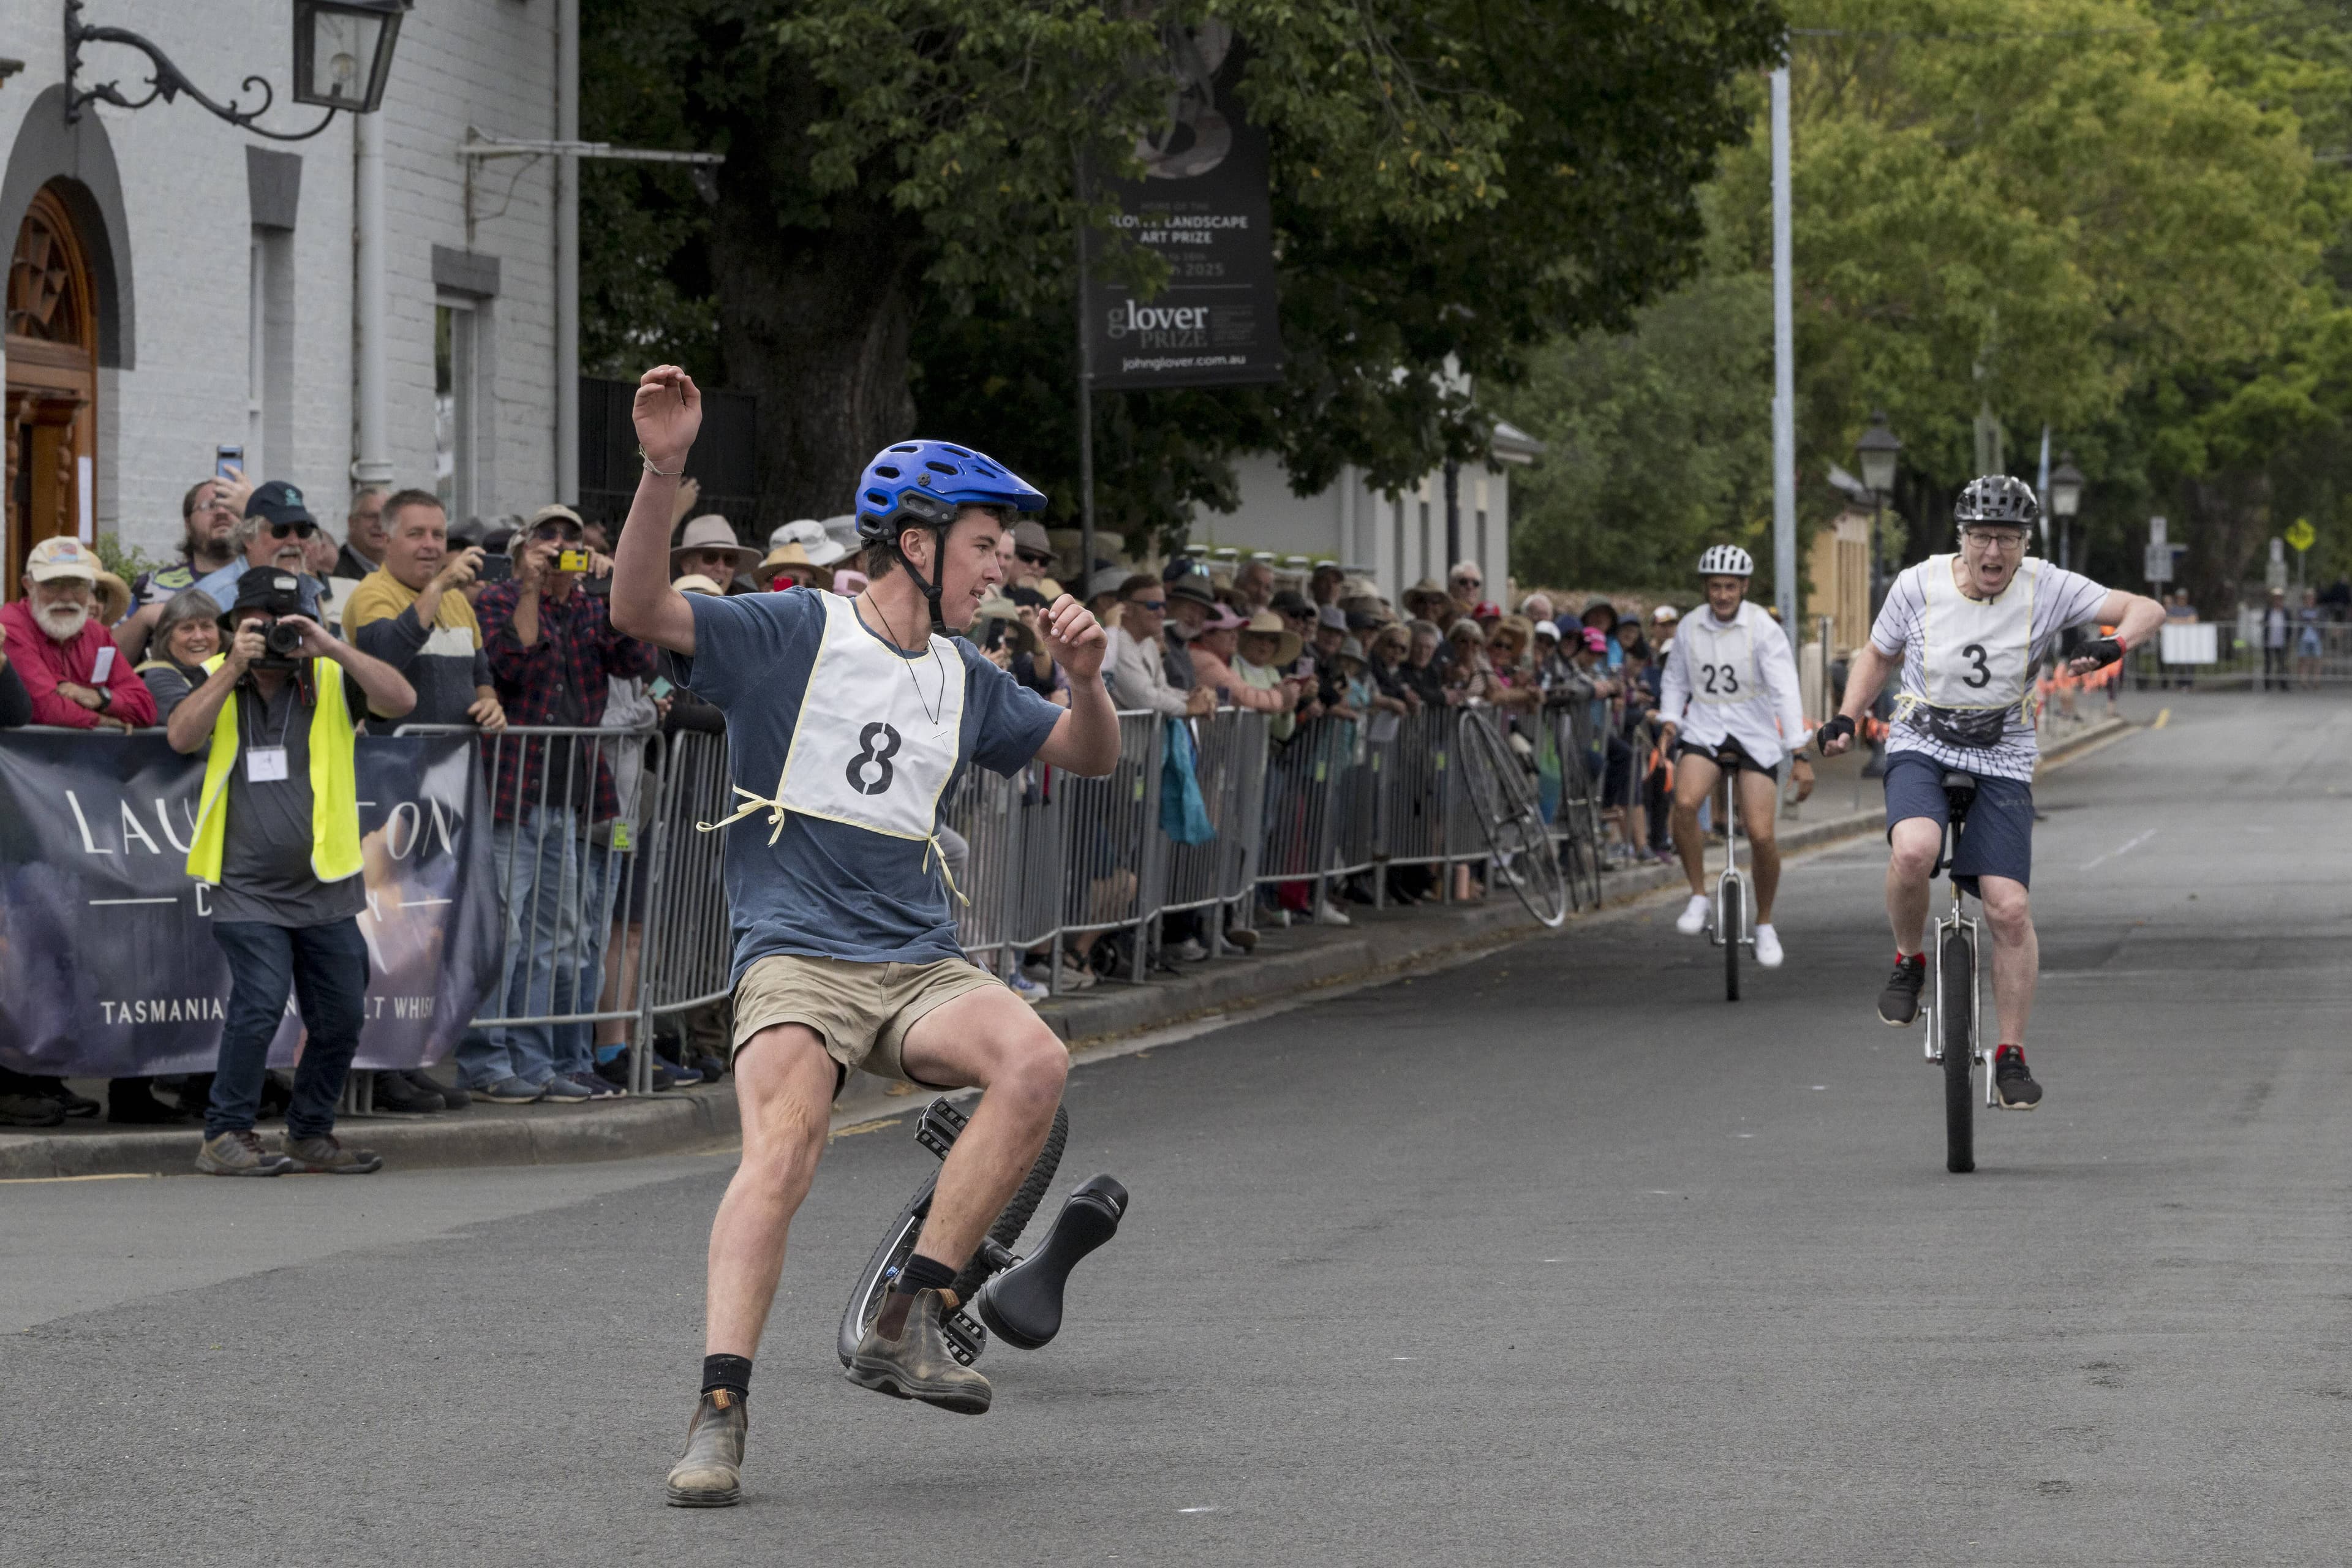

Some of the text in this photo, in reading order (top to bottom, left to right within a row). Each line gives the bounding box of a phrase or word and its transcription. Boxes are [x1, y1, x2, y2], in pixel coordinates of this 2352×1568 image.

[1164, 215, 1249, 229] LANDSCAPE
[1140, 231, 1213, 244] ART PRIZE
[1185, 262, 1224, 277] 2025
[1107, 299, 1209, 339] glover
[1140, 330, 1207, 348] PRIZE
[1123, 355, 1246, 372] johnglover.com.au
[1962, 644, 1991, 688] 3
[1702, 664, 1739, 694] 23
[846, 722, 902, 795] 8
[100, 997, 230, 1025] TASMANIA
